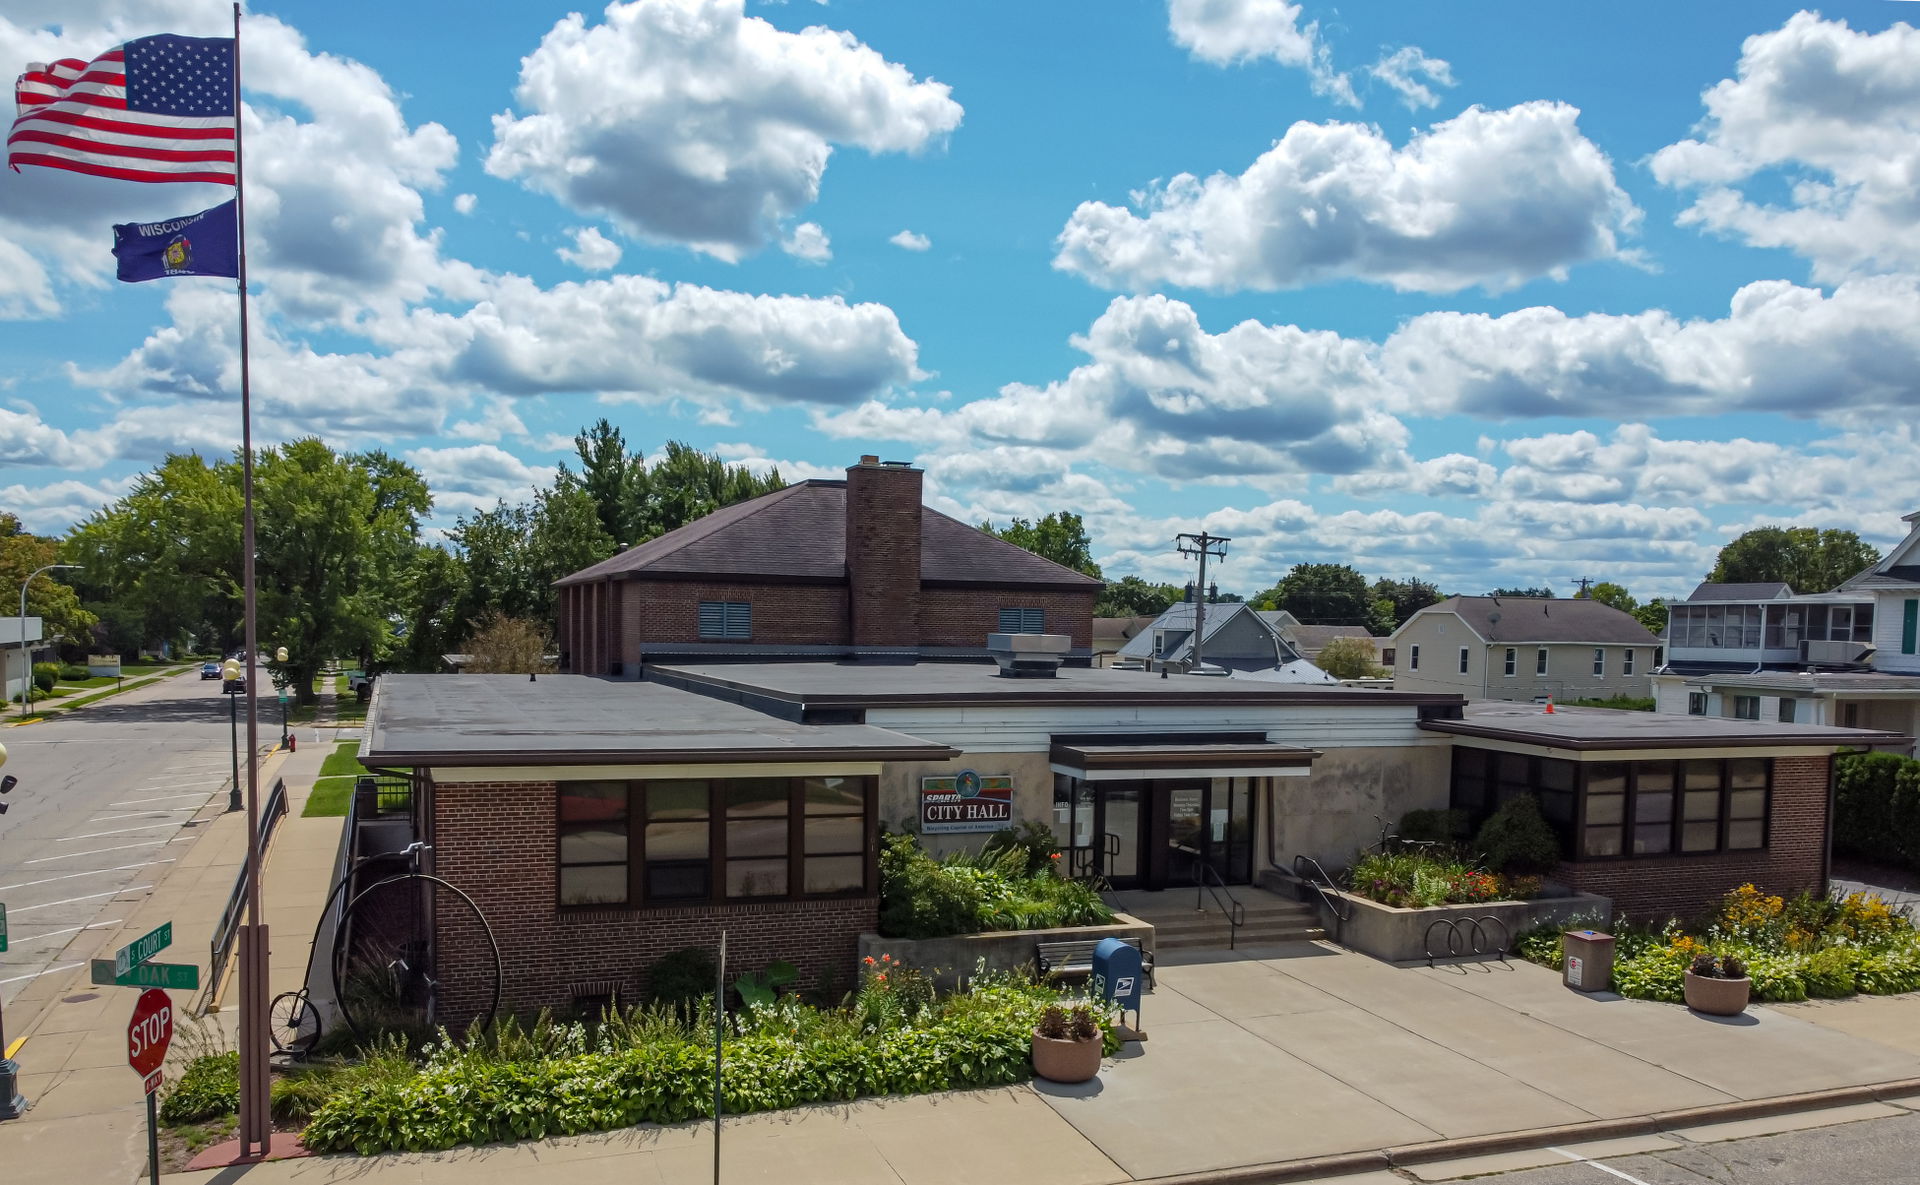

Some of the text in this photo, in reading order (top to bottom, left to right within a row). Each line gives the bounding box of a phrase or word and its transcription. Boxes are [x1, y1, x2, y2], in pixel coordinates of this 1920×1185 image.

[138, 213, 204, 237] WISCONSIN
[926, 793, 961, 803] SPARTA
[927, 804, 1008, 820] CITY HALL
[131, 929, 171, 960] S COURT ST
[140, 965, 170, 985] OAK
[131, 1006, 170, 1058] STOP
